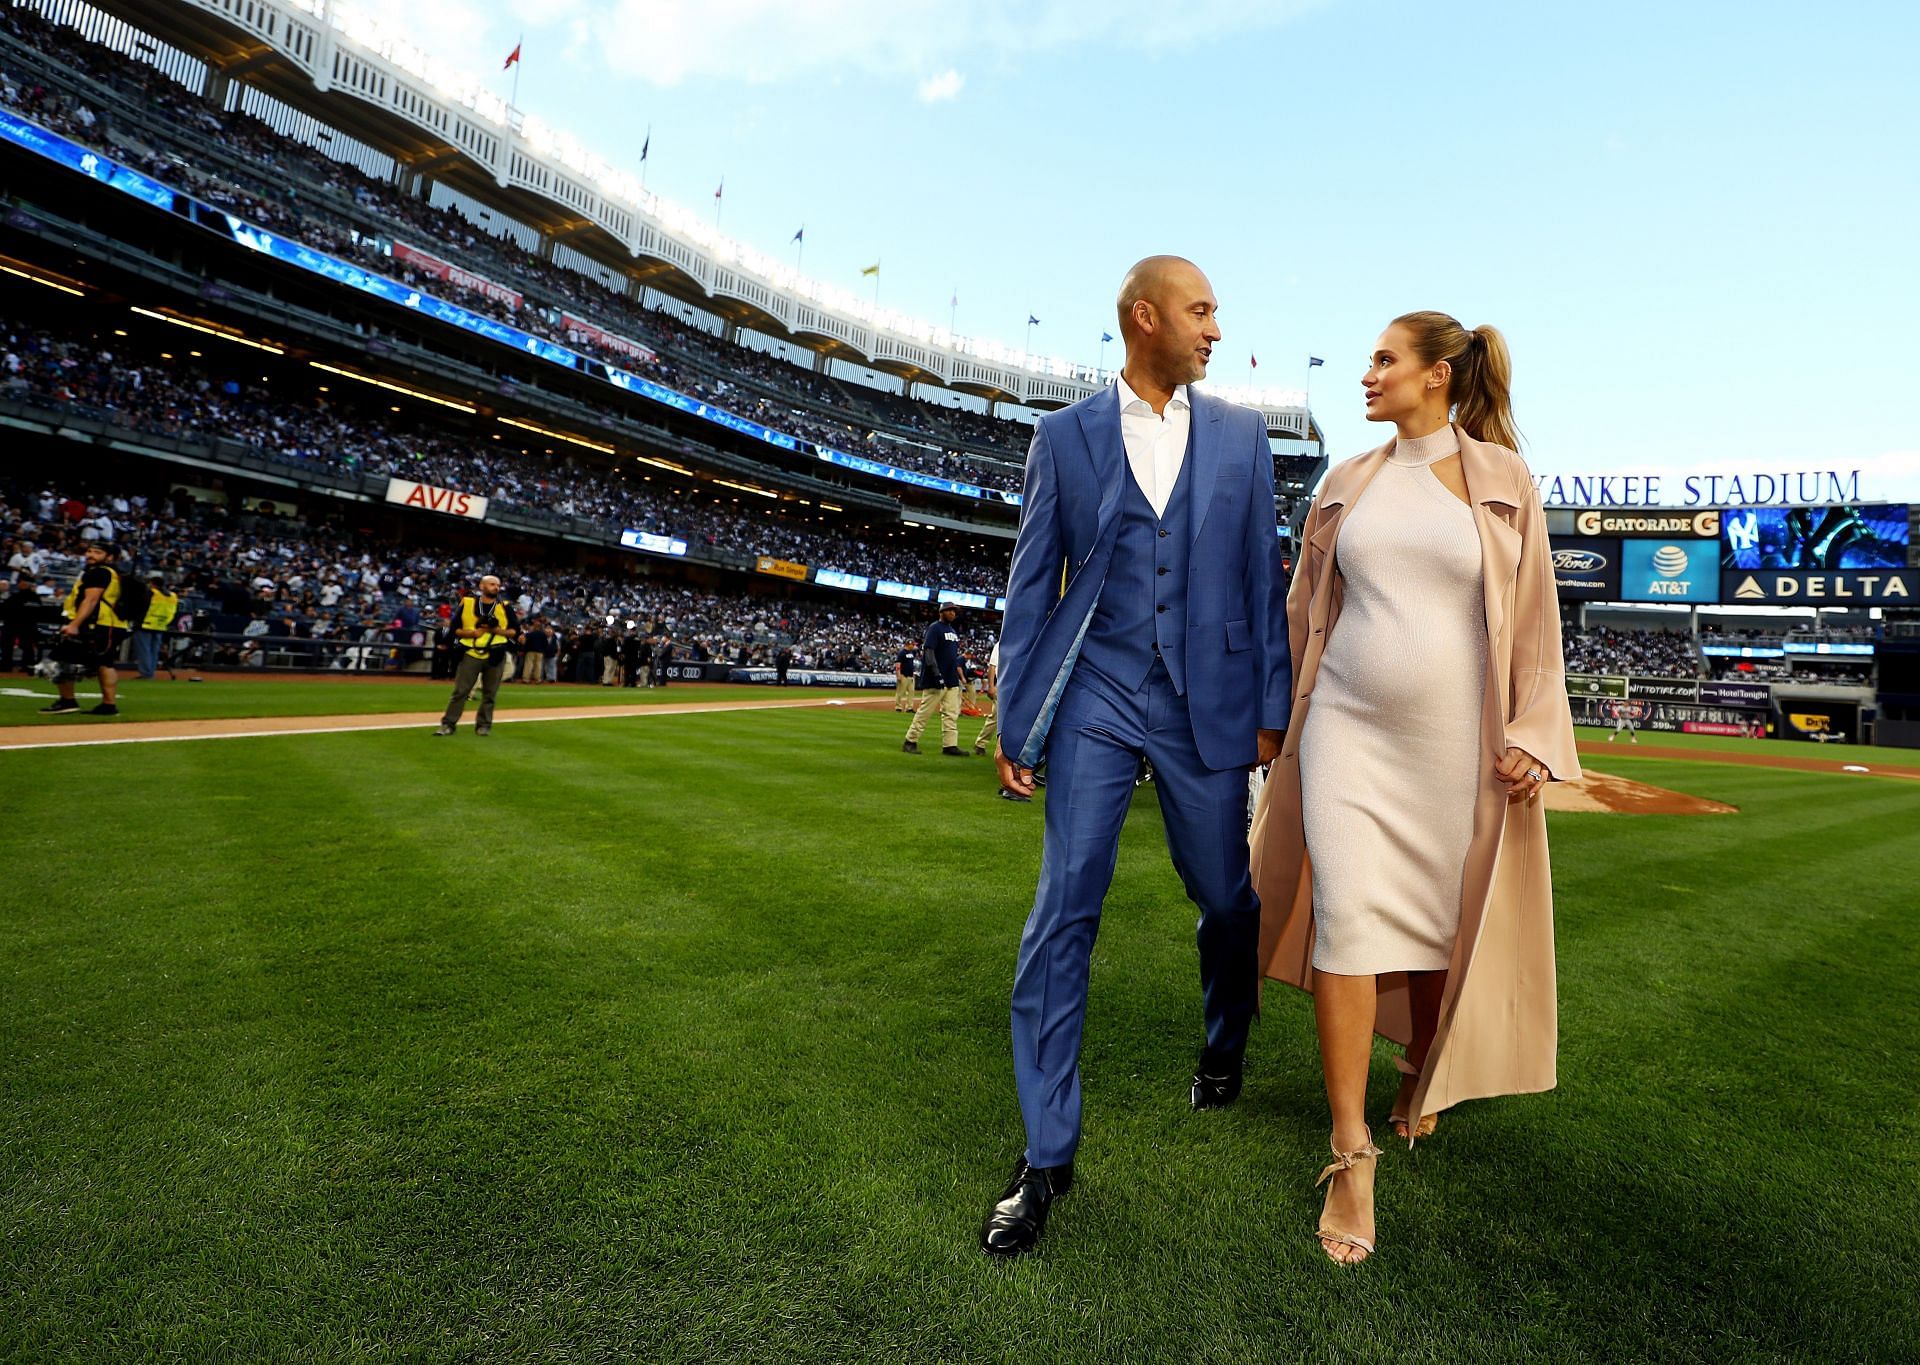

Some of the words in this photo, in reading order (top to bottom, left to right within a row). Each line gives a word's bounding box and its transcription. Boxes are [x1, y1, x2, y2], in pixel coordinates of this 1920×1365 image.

[1684, 470, 1862, 506] STADIUM
[406, 484, 471, 515] AVIS
[1603, 518, 1691, 532] GATORADE
[1554, 552, 1595, 570] Ford
[1648, 581, 1691, 595] AT&T
[1776, 576, 1909, 597] DELTA
[749, 672, 800, 682] WEATHEROOF
[1718, 688, 1768, 700] HotelTonight
[1573, 716, 1601, 726] ubHub
